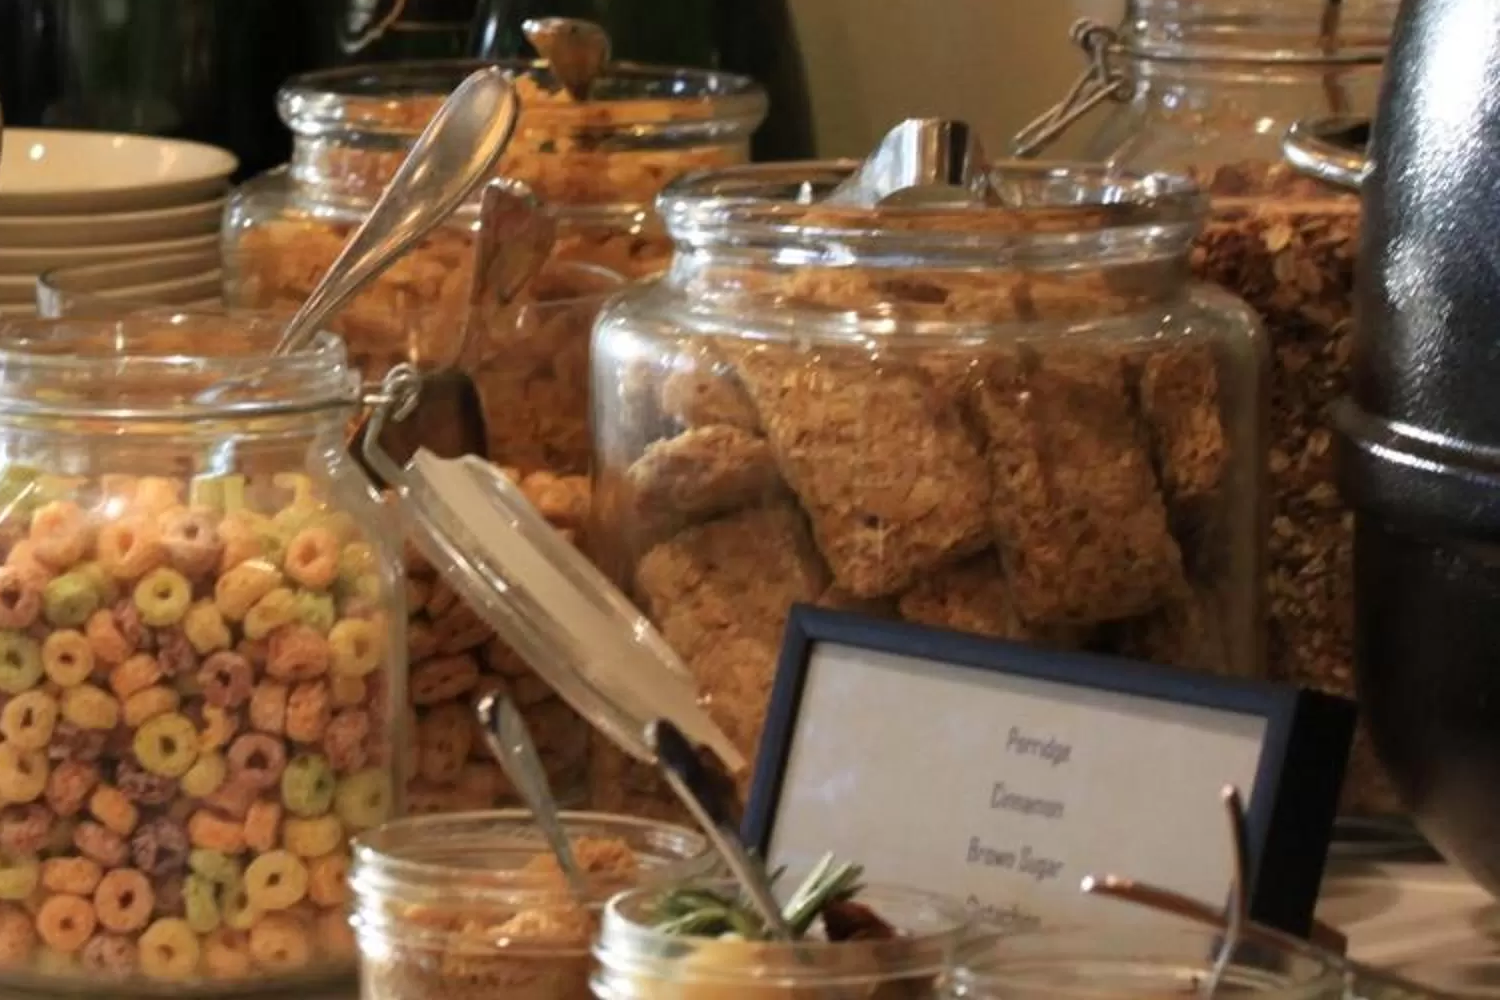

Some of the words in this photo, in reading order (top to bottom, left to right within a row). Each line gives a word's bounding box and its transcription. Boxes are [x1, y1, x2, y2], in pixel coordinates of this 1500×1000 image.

[1006, 725, 1072, 766] Porridge
[966, 836, 1016, 869] Brown
[1018, 845, 1065, 882] Sugar
